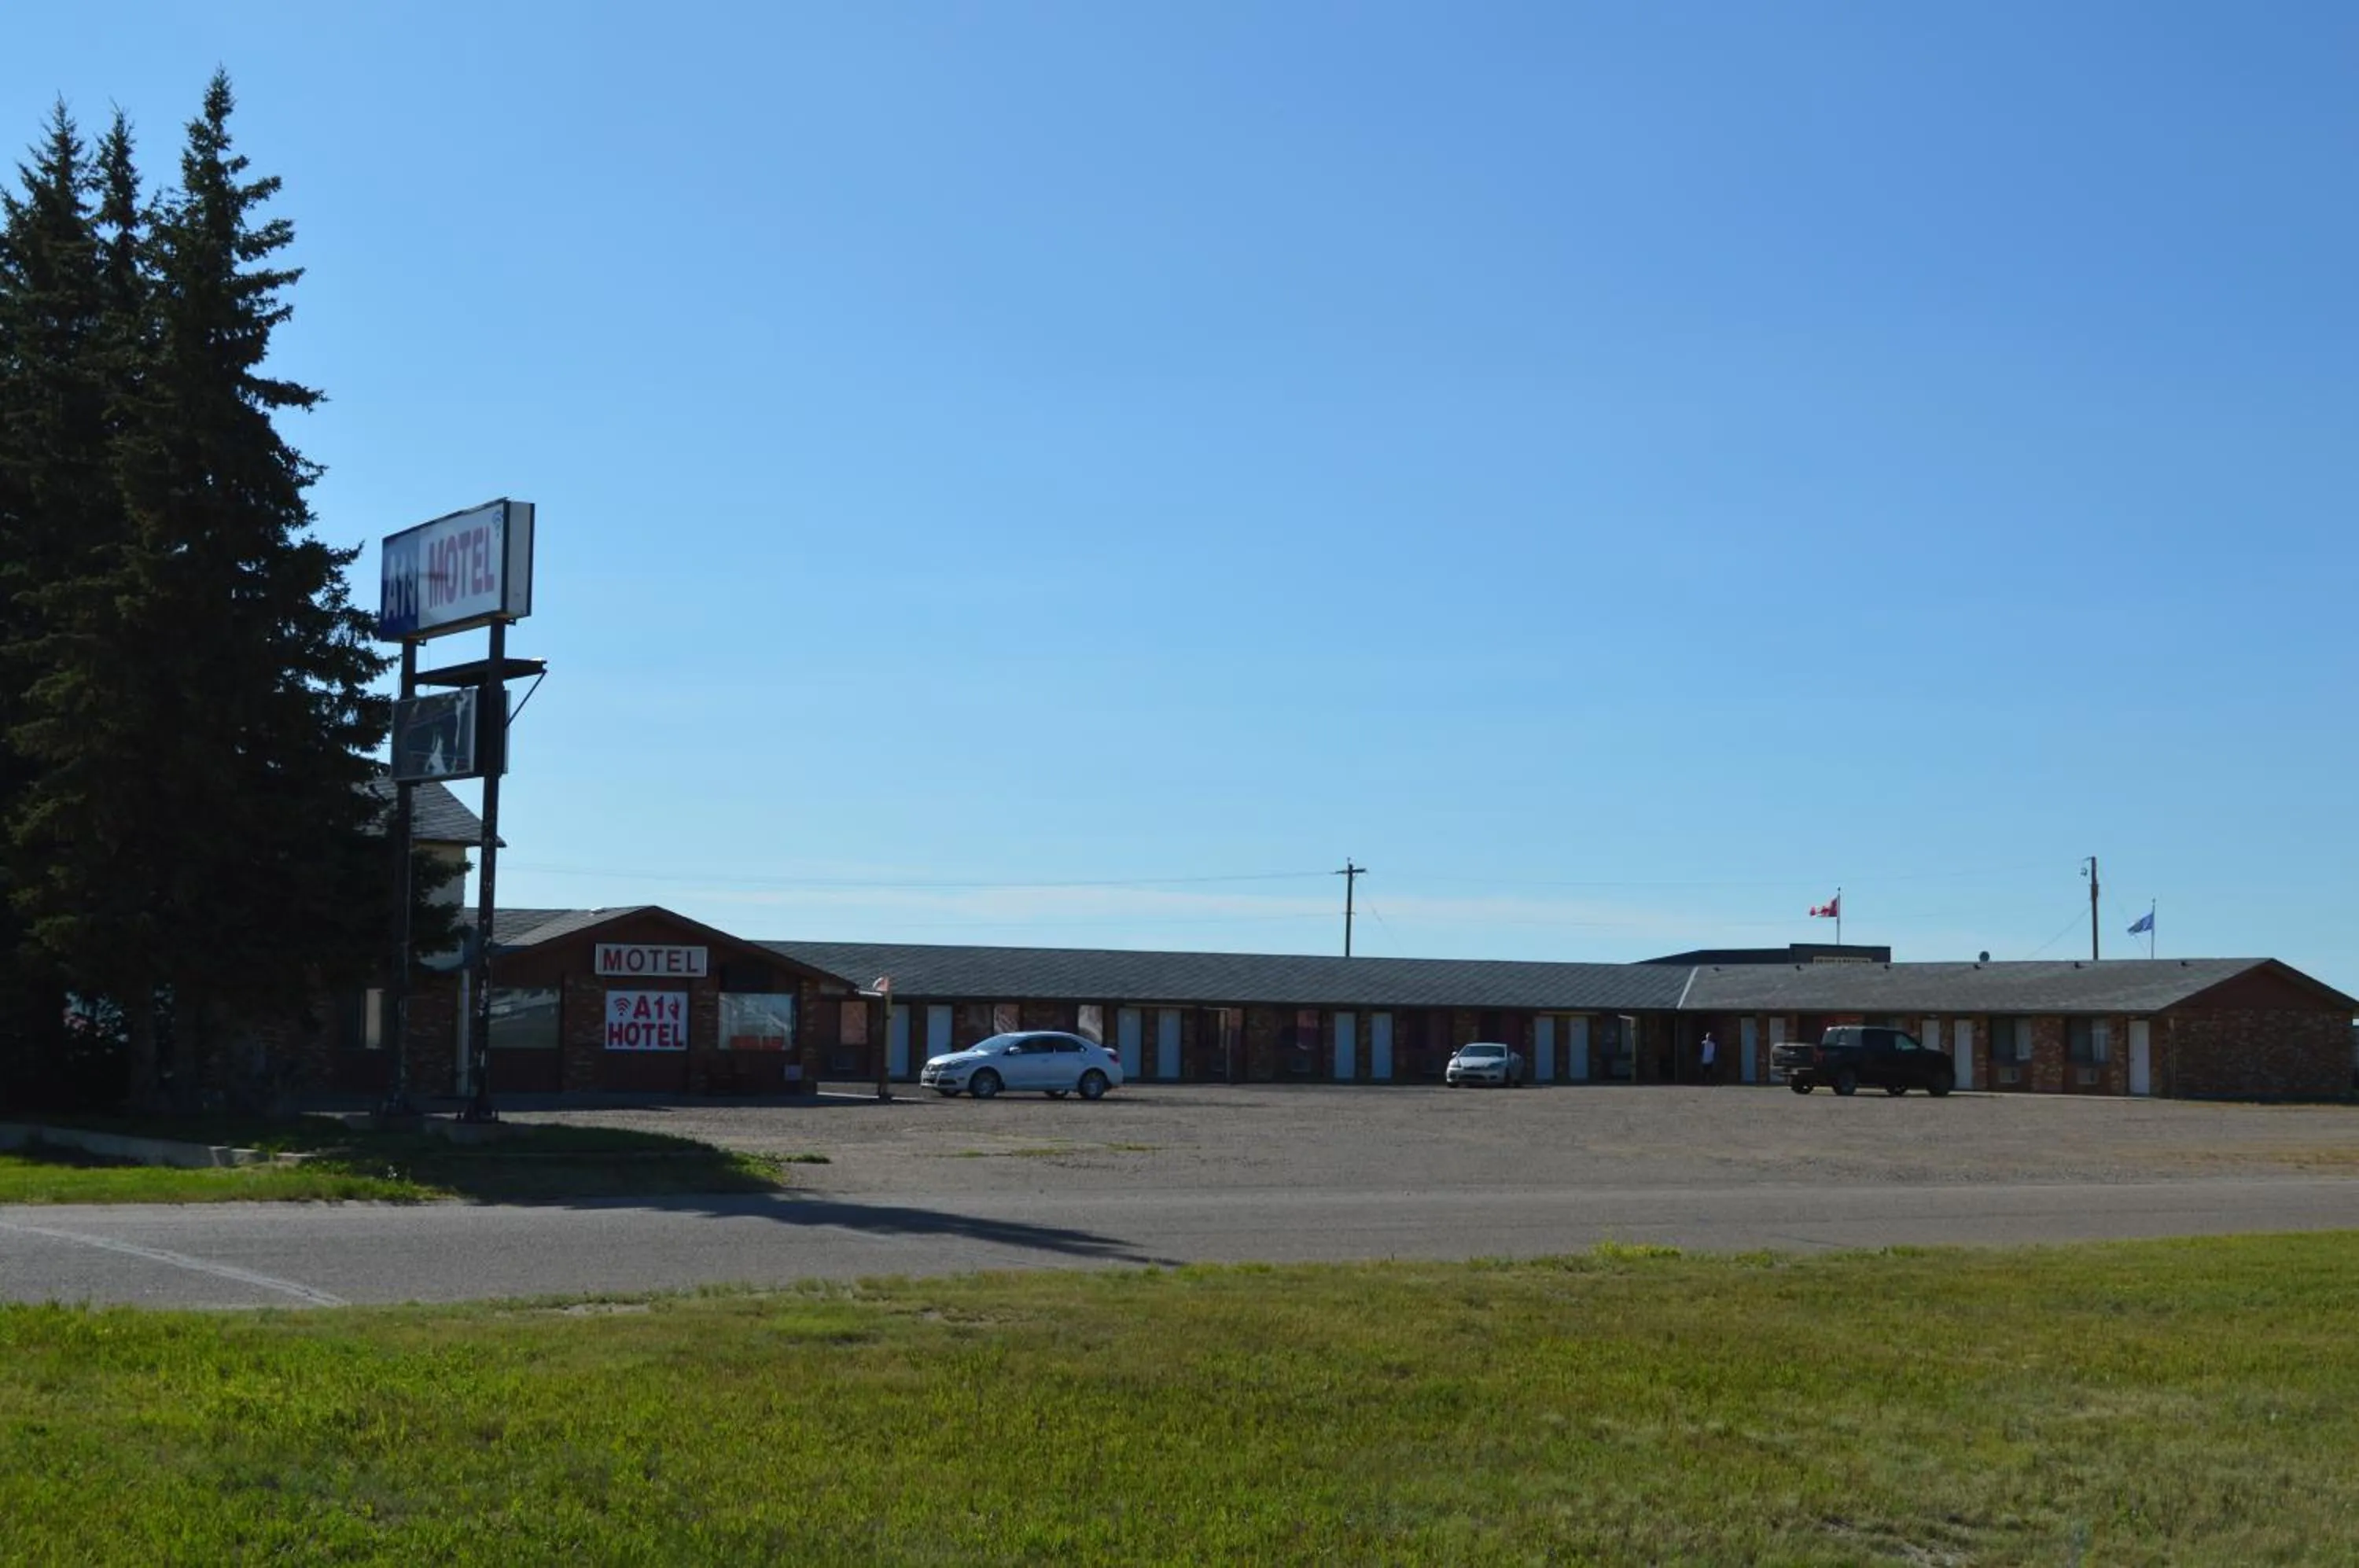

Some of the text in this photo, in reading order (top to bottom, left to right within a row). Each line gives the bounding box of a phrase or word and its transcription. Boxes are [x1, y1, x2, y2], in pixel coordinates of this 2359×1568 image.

[429, 525, 495, 609] MOTEL
[603, 948, 697, 973] MOTEL
[633, 995, 664, 1020] A1
[608, 1021, 684, 1047] HOTEL
